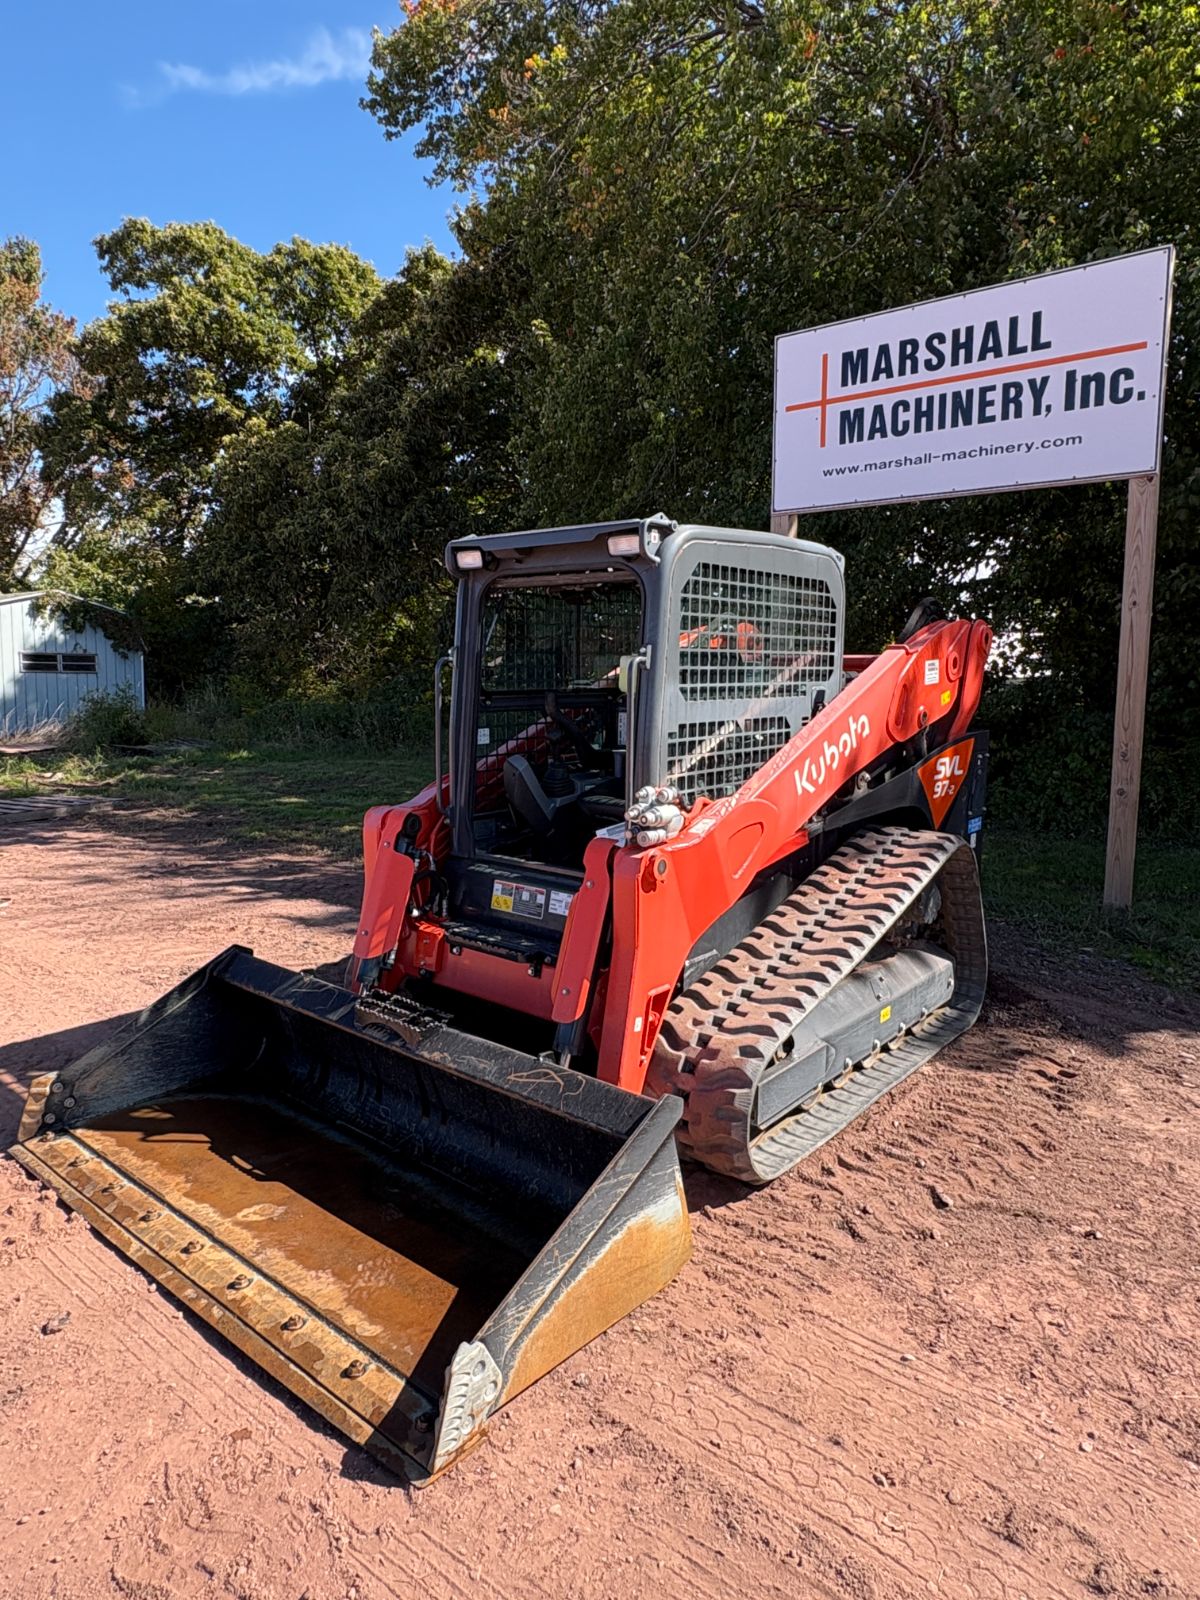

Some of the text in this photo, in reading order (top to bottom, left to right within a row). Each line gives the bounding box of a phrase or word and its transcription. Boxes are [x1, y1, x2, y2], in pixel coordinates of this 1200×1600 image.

[840, 310, 1052, 388] MARSHALL
[838, 367, 1147, 446] MACHINERY, Inc.
[822, 434, 1083, 477] www.marshall-machinery.com
[793, 713, 871, 796] Kubota
[933, 755, 964, 780] SVL
